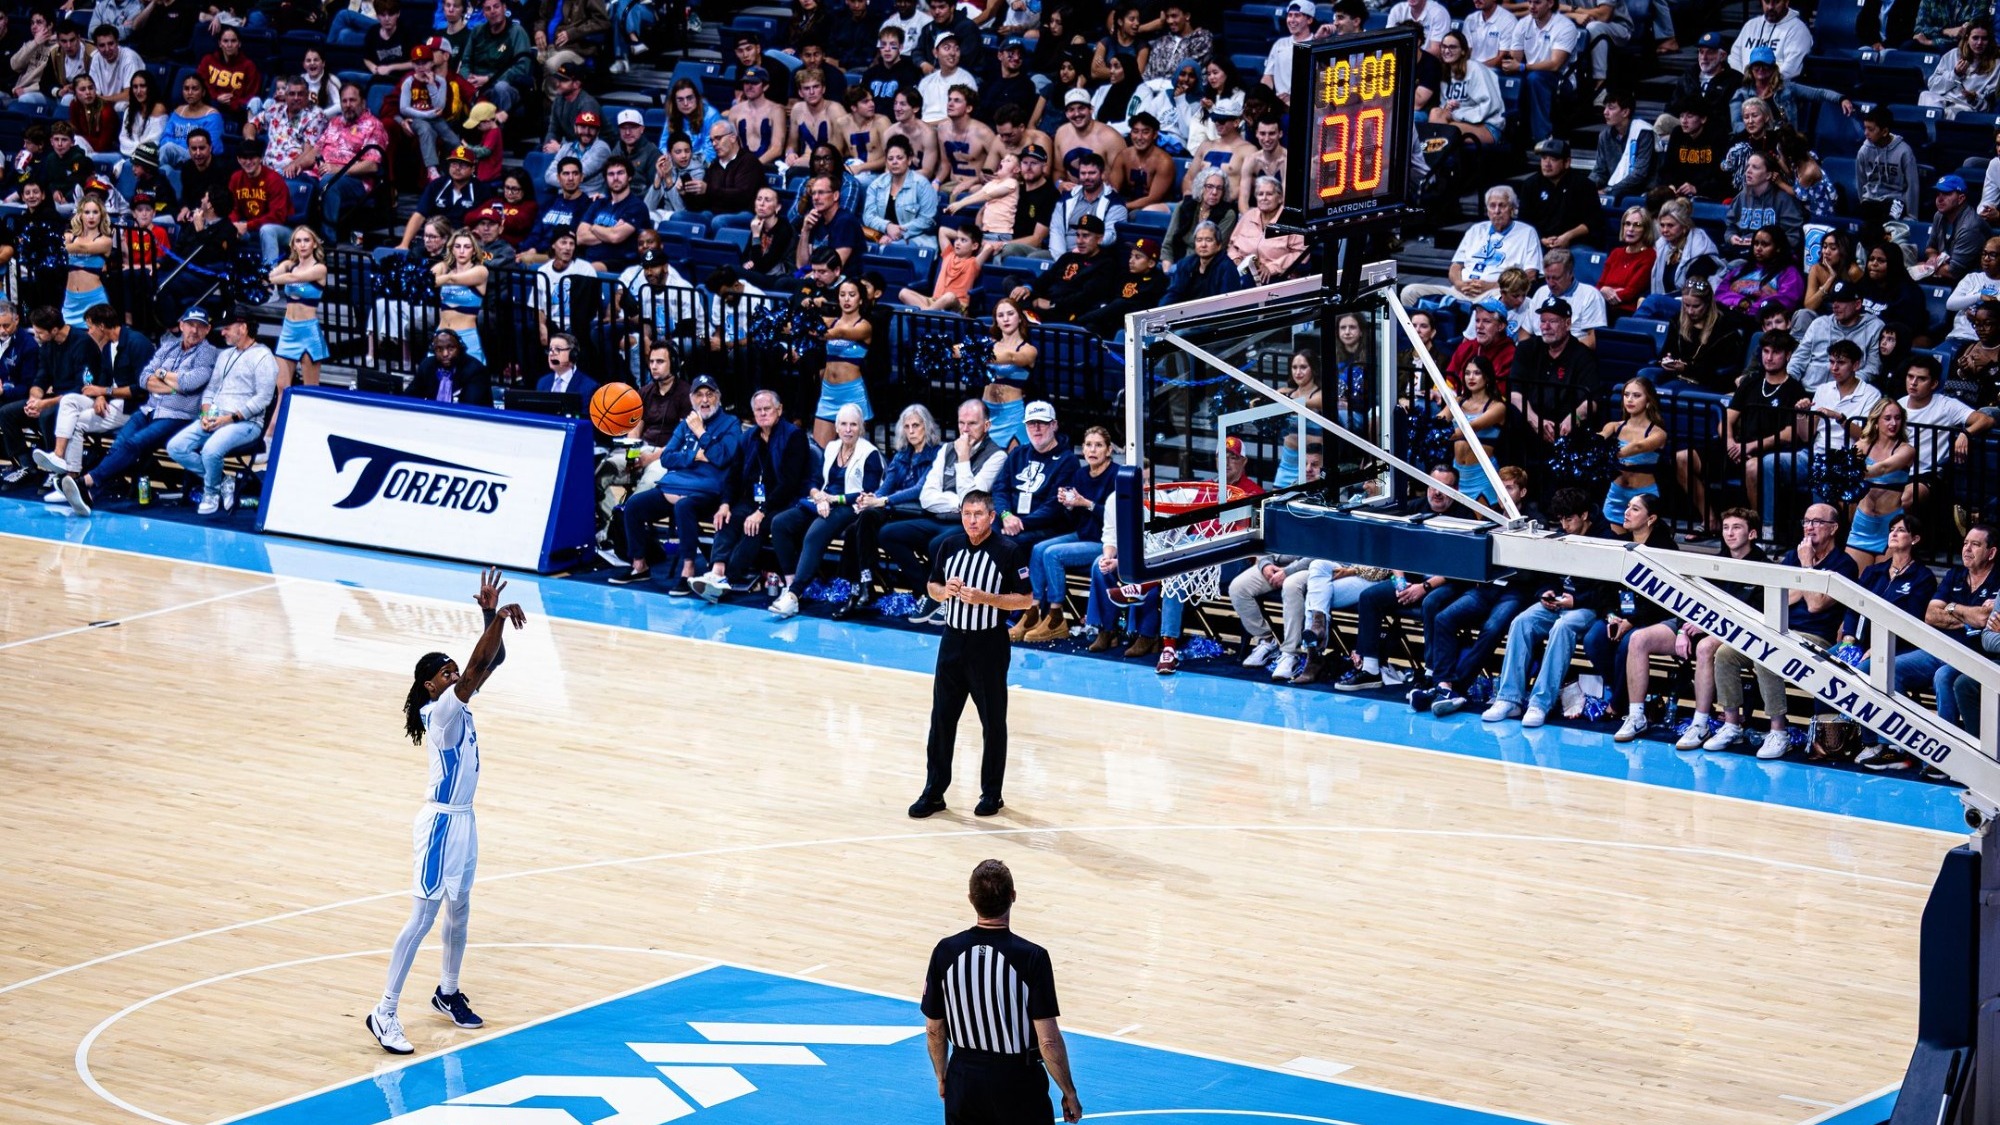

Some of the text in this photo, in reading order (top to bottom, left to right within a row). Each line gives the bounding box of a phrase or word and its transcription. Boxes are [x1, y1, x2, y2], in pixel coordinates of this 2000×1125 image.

[208, 64, 245, 89] USC
[1322, 52, 1396, 106] 10:00
[1319, 108, 1385, 198] 30
[1326, 199, 1378, 216] DAKTRONICS
[1741, 206, 1776, 231] USD
[327, 434, 512, 515] TOREROS
[1624, 562, 1952, 764] UNIVERSITY OF SAN DIEGO
